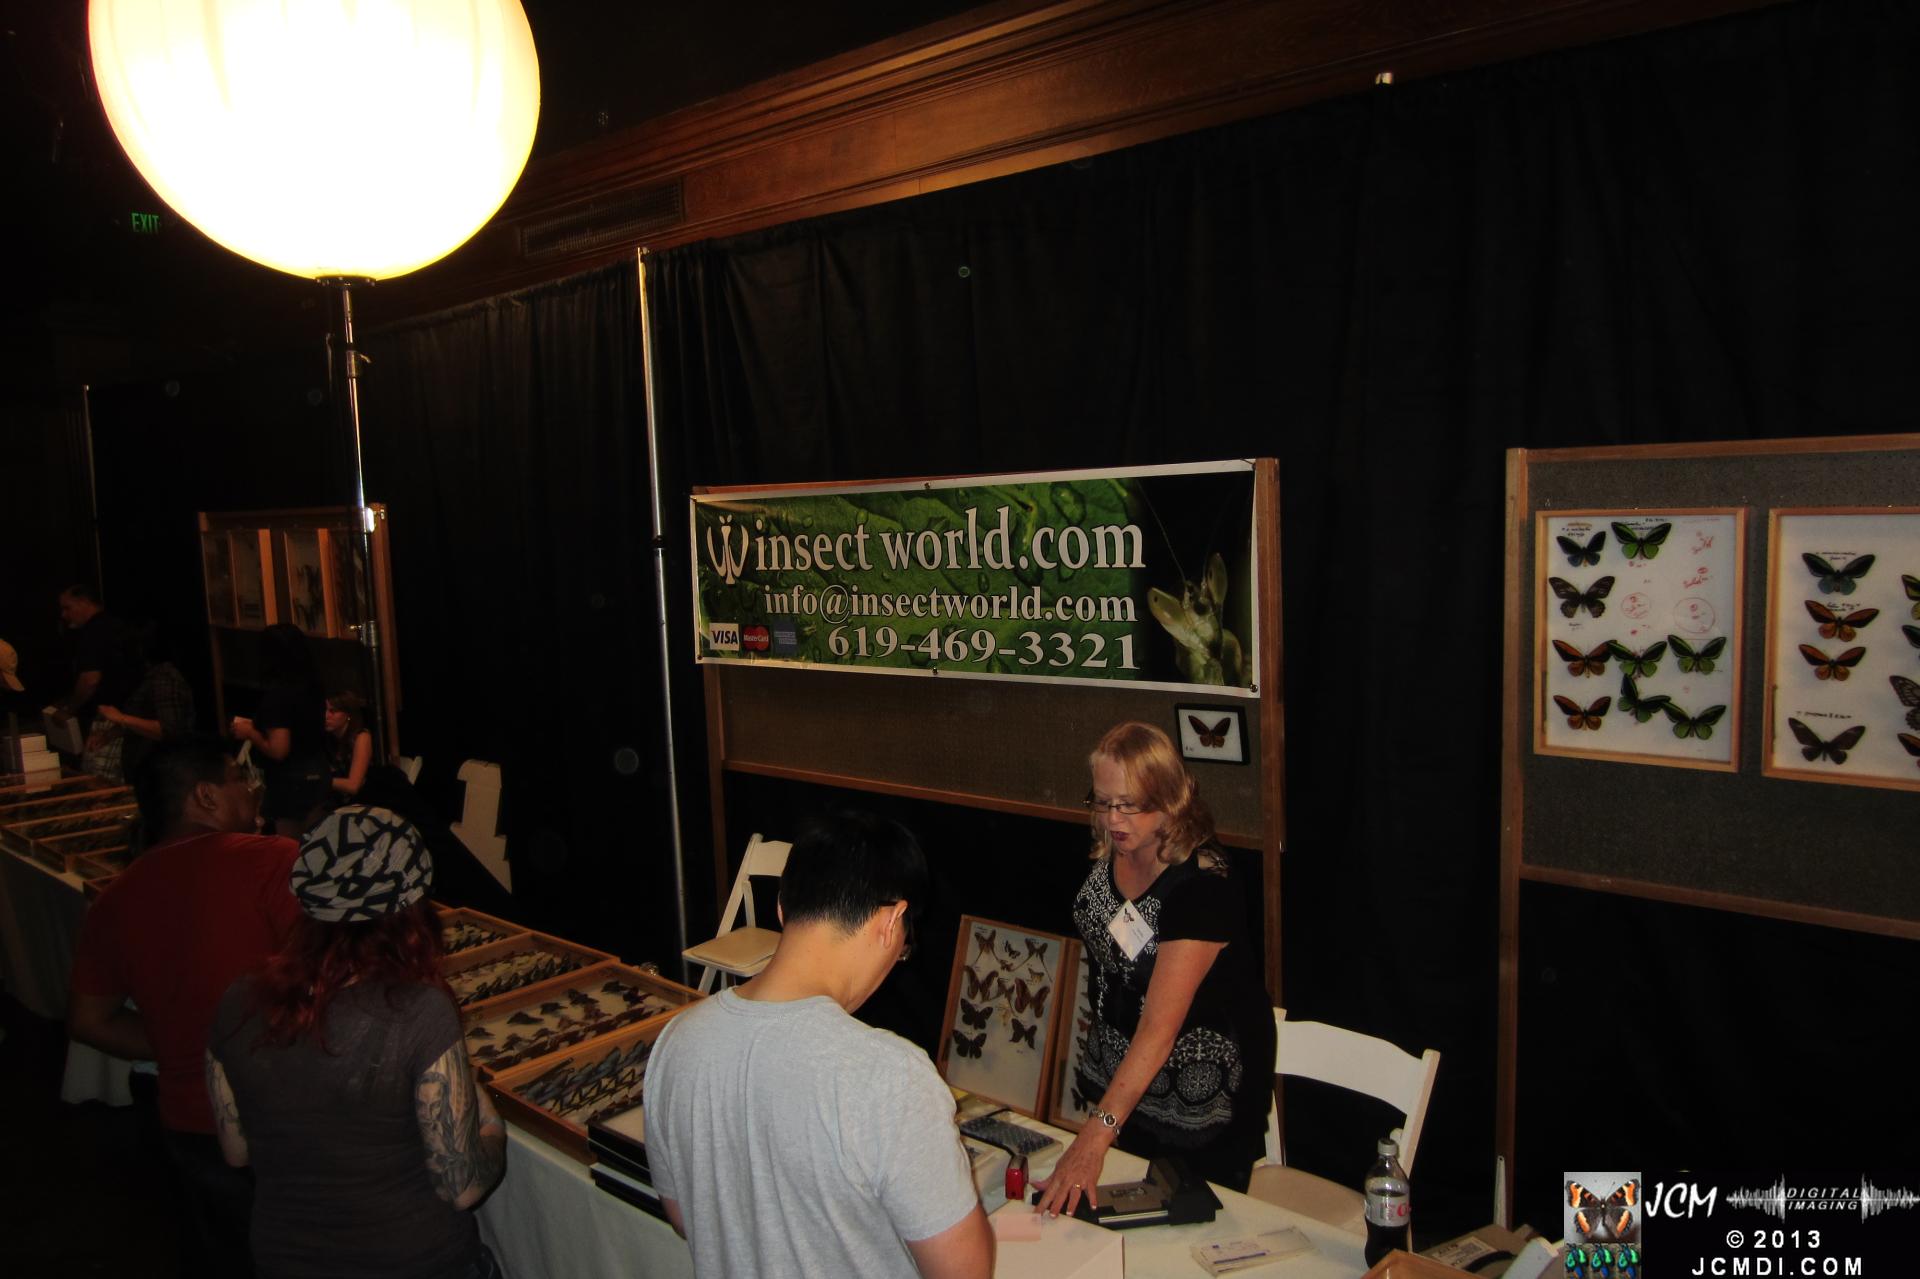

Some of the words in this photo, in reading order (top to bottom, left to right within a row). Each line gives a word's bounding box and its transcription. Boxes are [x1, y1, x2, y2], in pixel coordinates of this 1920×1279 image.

[131, 212, 159, 234] EXIT
[755, 519, 874, 571] insect
[879, 505, 1147, 571] world.com
[764, 584, 1139, 624] info@insectworld.com
[712, 630, 738, 645] VISA
[828, 625, 1141, 670] 619-469-3321
